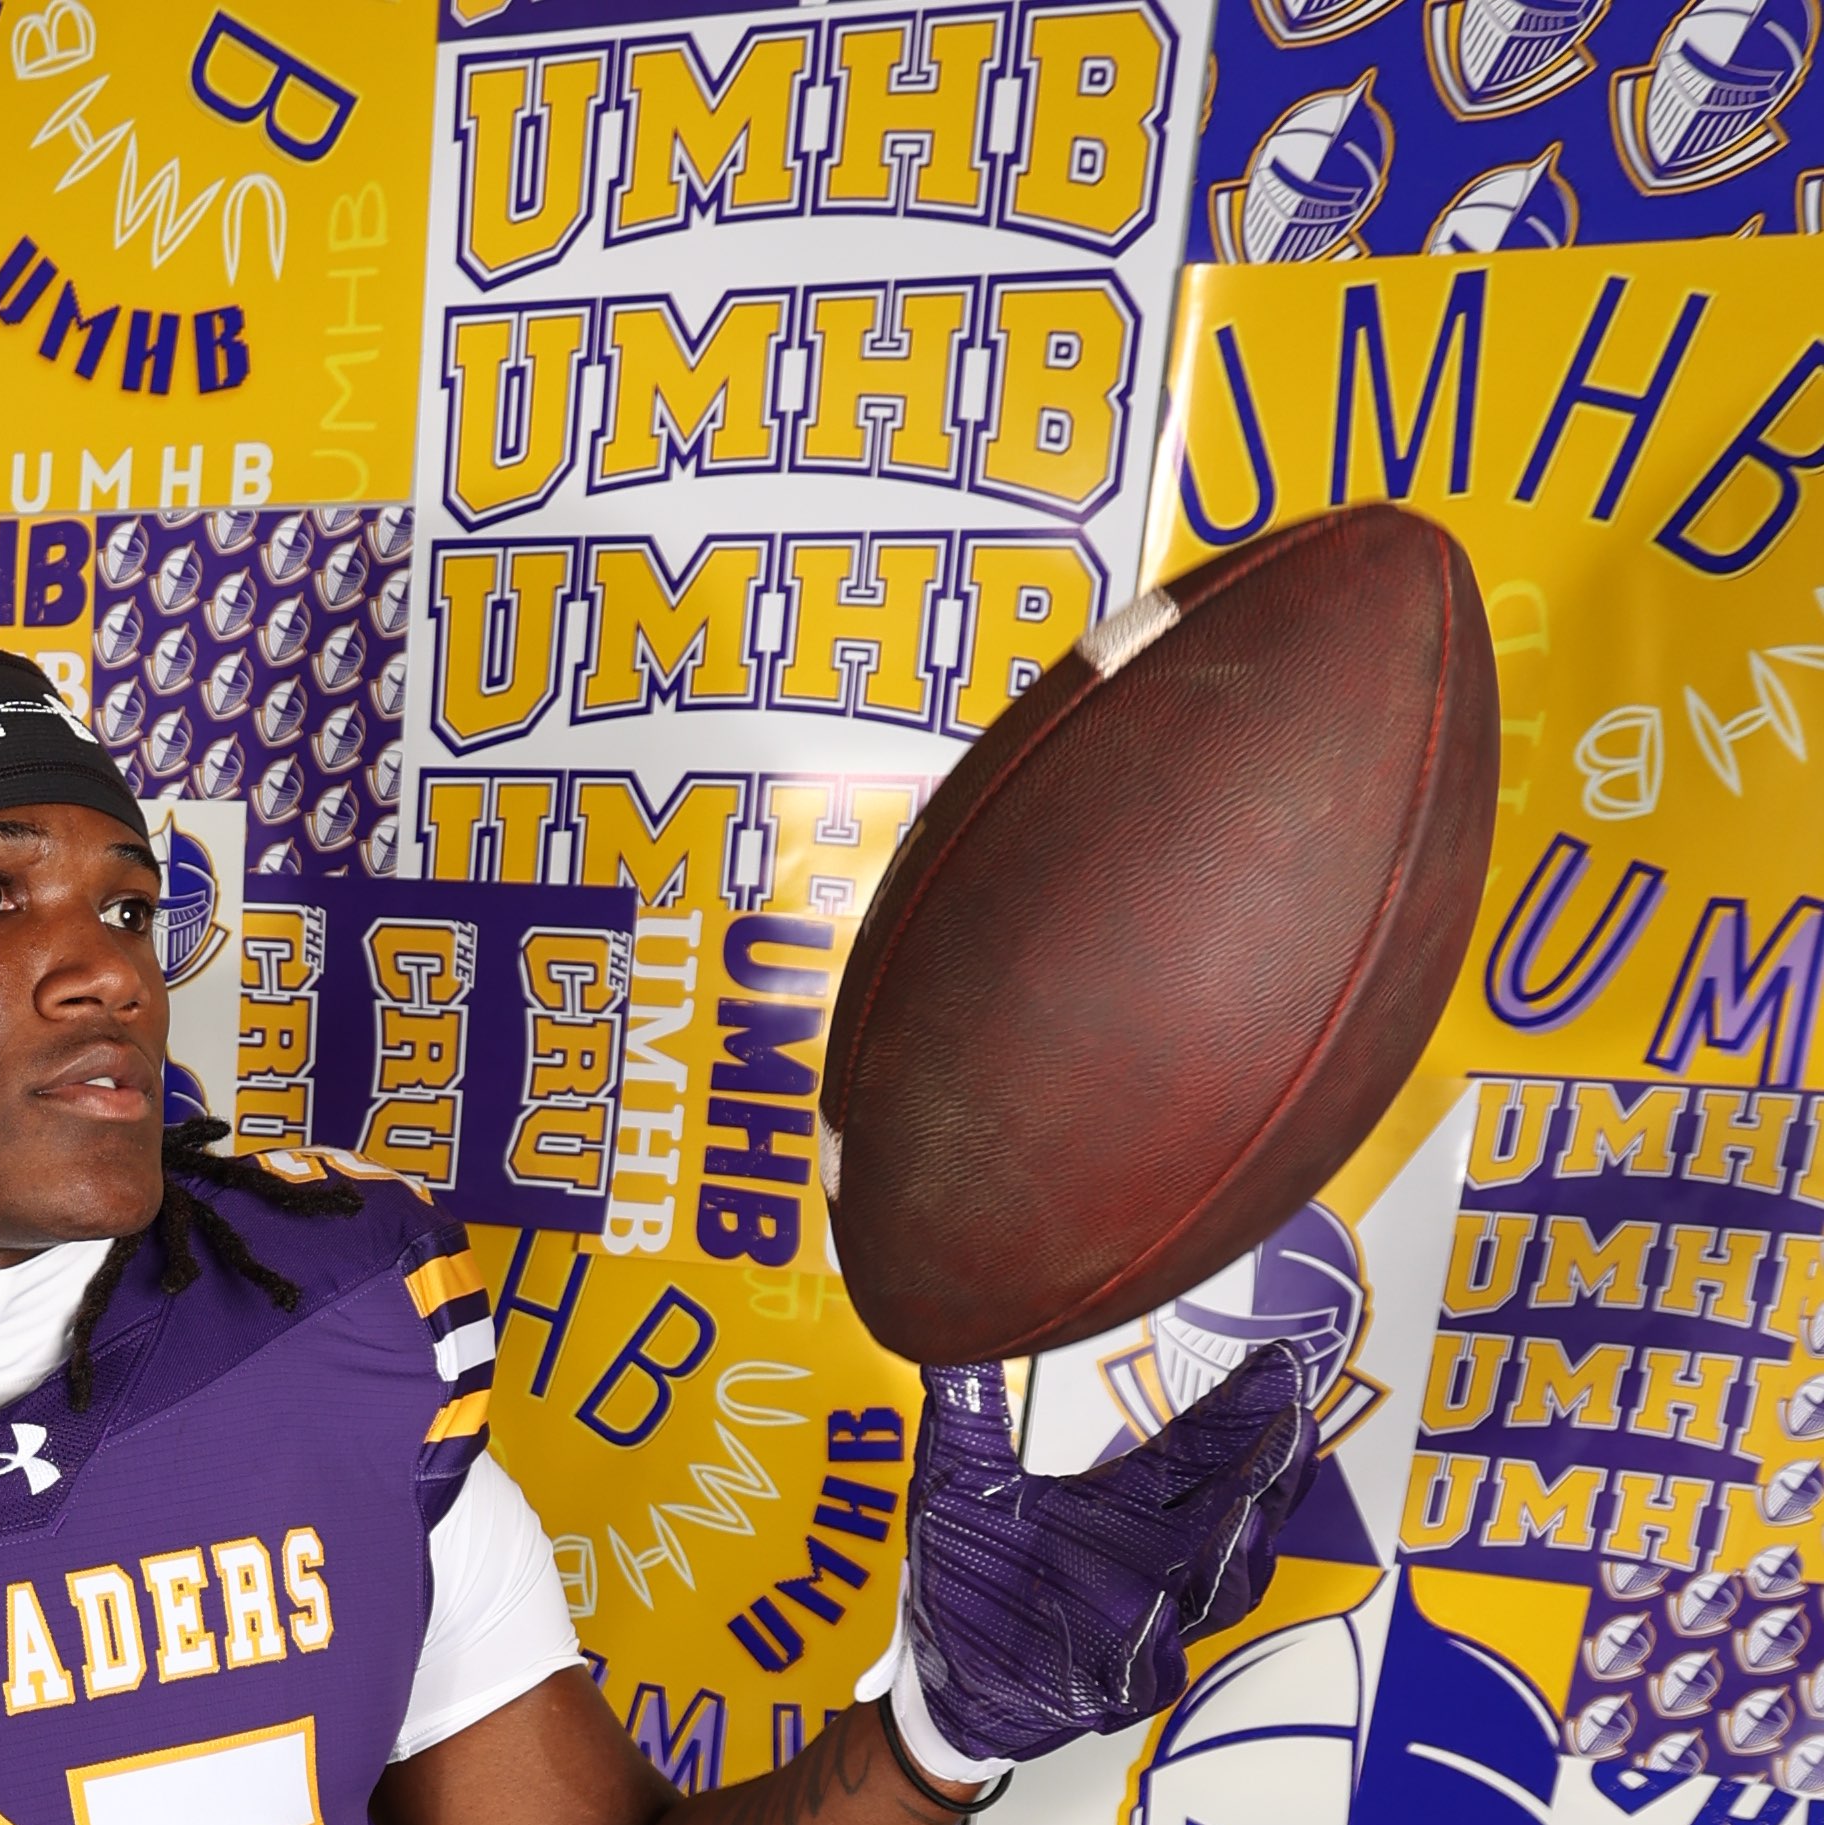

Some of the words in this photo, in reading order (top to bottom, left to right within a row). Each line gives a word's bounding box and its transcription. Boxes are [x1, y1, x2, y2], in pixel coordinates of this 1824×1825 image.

[453, 0, 1178, 292] UMHB
[11, 442, 273, 513] UMHB
[441, 269, 1141, 532] UMHB
[356, 917, 469, 1192] CRU
[453, 921, 479, 990] THE
[504, 926, 630, 1198] CRU
[601, 909, 702, 1257] UMHB
[607, 929, 632, 997] THE
[695, 914, 834, 1268] UMHB
[728, 1406, 905, 1673] UMHB
